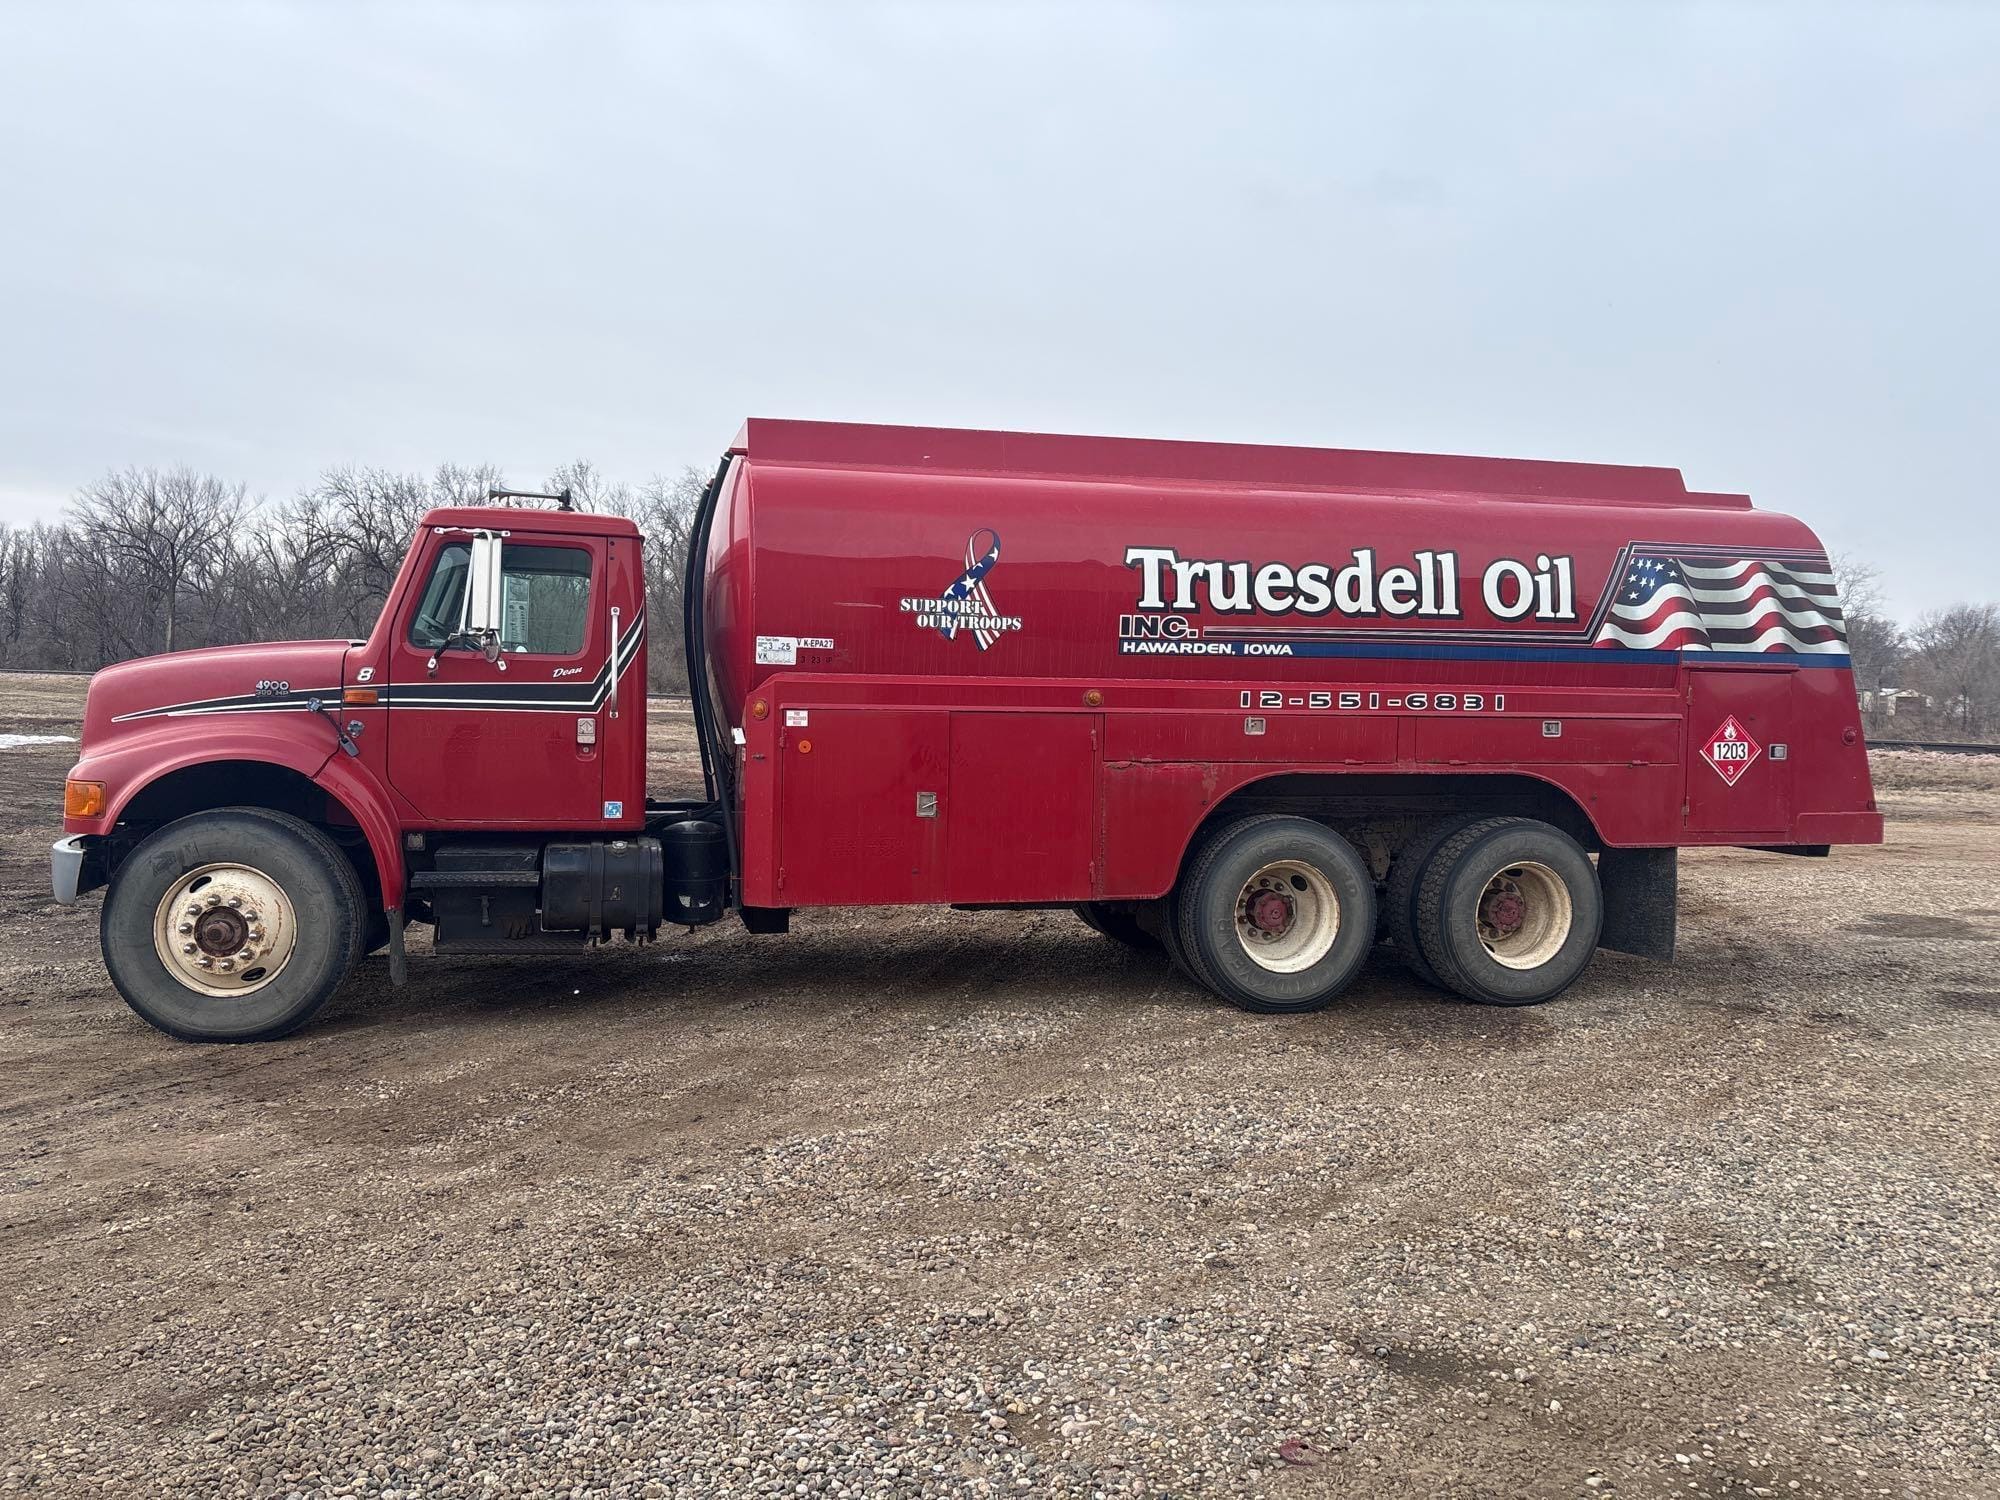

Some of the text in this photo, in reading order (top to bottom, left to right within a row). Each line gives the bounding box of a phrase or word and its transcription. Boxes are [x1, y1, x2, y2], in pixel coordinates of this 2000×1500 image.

[1125, 547, 1577, 619] Truesdell Oil
[900, 598, 982, 614] SUPPORT
[917, 614, 1021, 630] OUR TROOPS
[1119, 615, 1199, 639] INC.
[1123, 641, 1293, 655] HAWARDEN, IOWA
[357, 667, 374, 682] 8
[553, 667, 583, 678] Dean
[256, 680, 289, 690] 4900
[1717, 743, 1746, 759] 1203
[1727, 765, 1734, 775] 3
